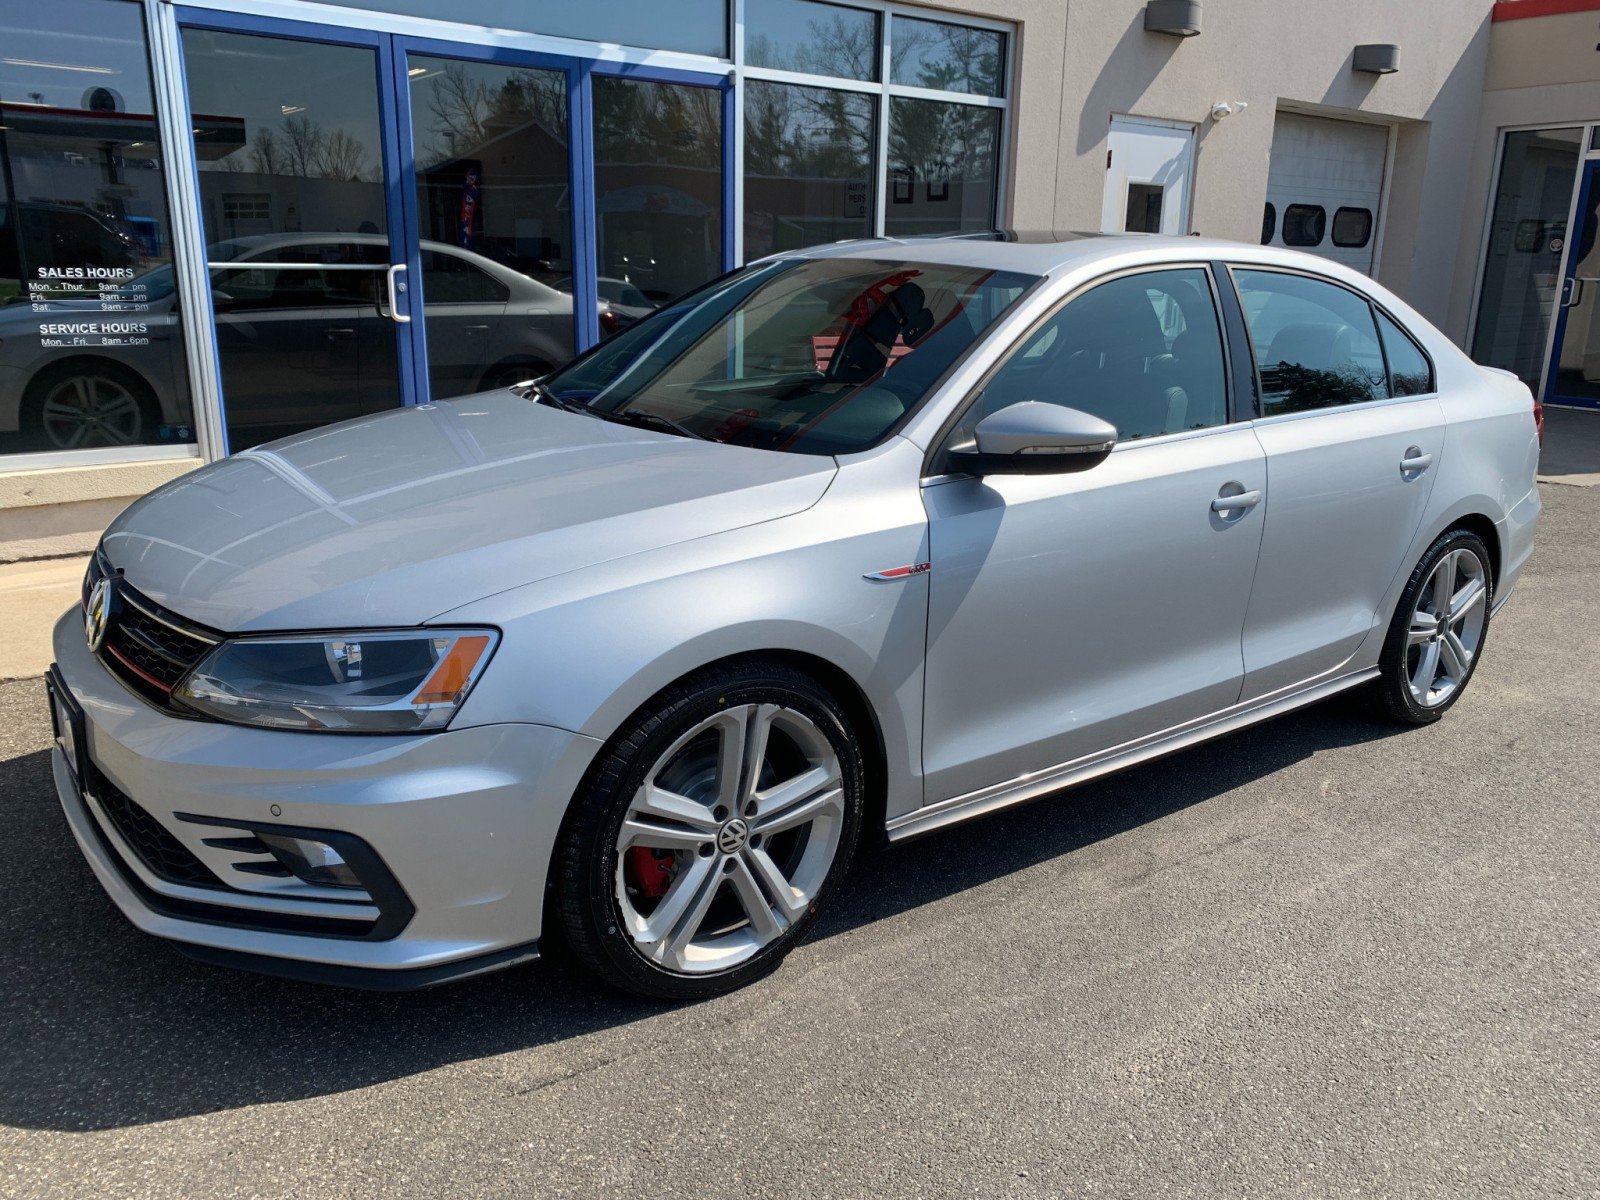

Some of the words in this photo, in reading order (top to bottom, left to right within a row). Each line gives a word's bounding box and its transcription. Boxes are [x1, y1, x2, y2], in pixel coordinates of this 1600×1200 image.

[38, 267, 83, 278] SALES
[86, 267, 134, 278] HOURS
[28, 282, 53, 291] Mon.
[60, 282, 85, 291] Thur.
[98, 282, 119, 291] 9am
[30, 292, 46, 301] Fri.
[99, 292, 120, 301] 9am
[133, 294, 148, 302] pm
[101, 302, 122, 311] 9am
[39, 324, 98, 335] SERVICE
[101, 323, 147, 333] HOURS
[41, 338, 65, 347] Mon.
[101, 336, 122, 345] 8am
[718, 818, 747, 854] VW
